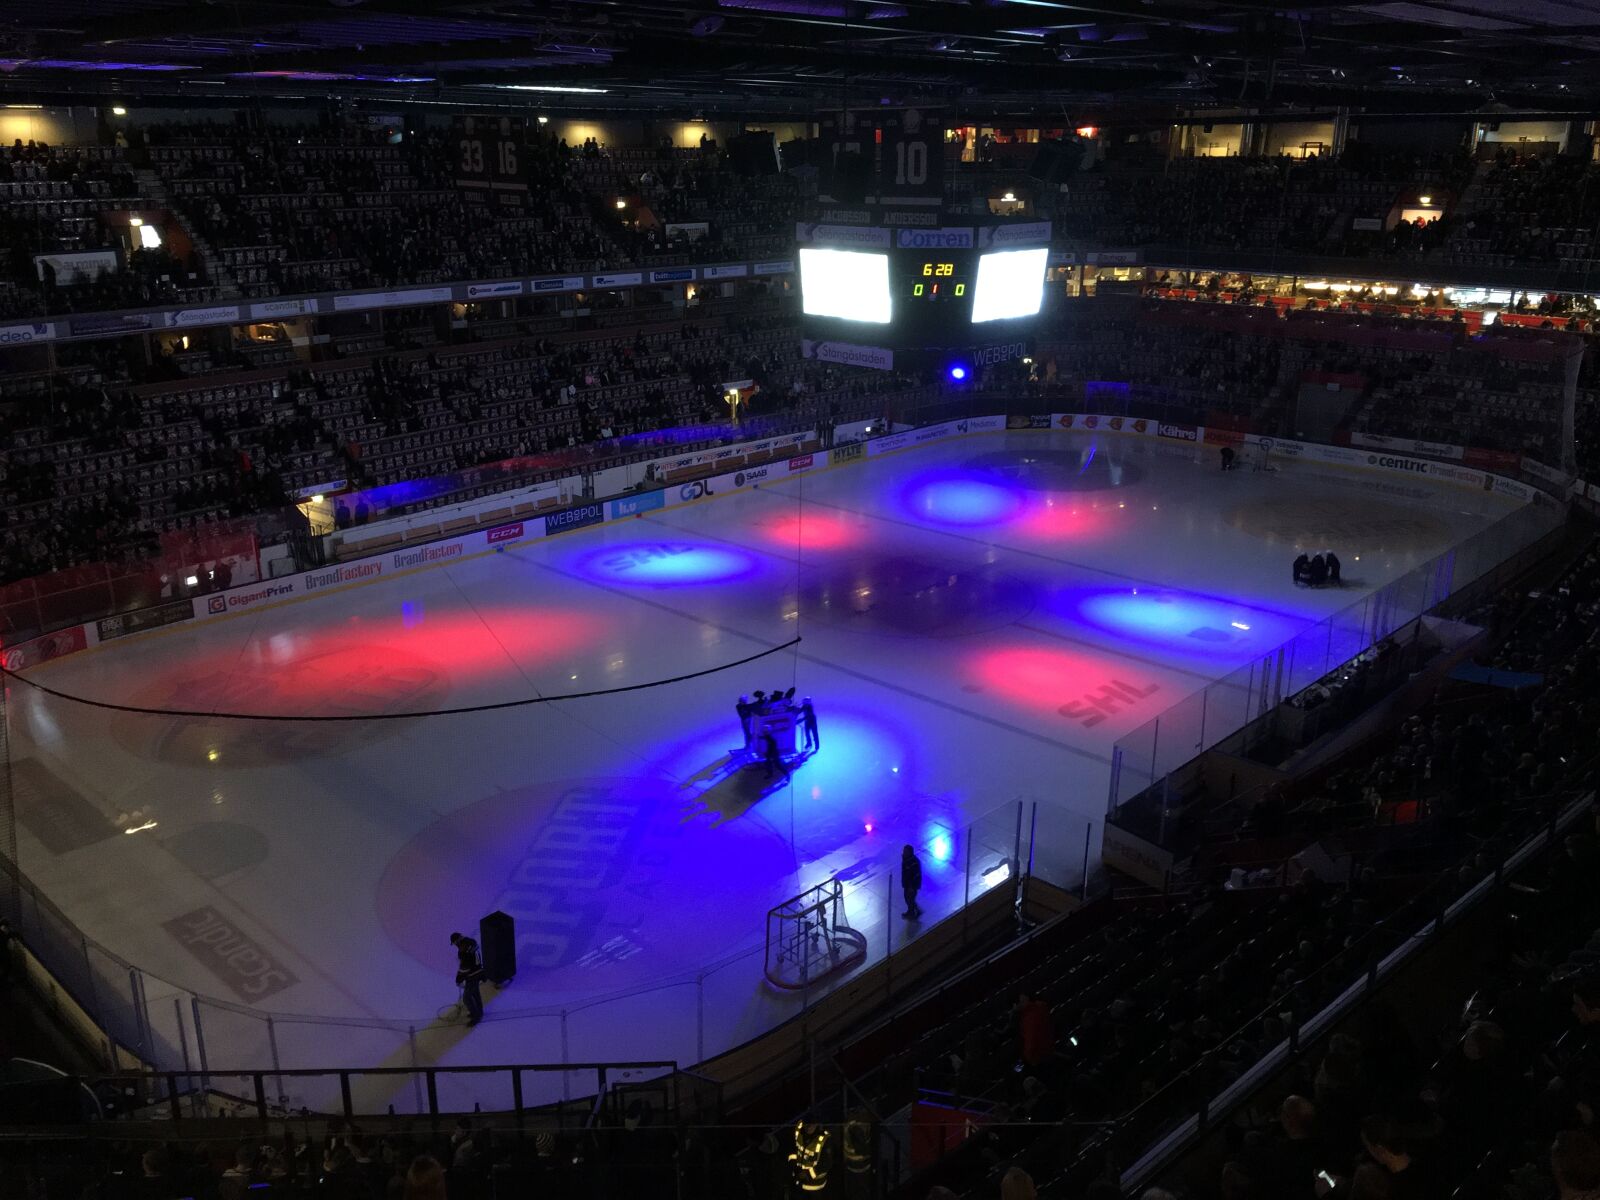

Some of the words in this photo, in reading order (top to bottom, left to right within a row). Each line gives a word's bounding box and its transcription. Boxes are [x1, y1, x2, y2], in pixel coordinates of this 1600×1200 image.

[460, 140, 484, 172] 33
[497, 141, 517, 175] 16
[896, 141, 927, 184] 10
[883, 212, 937, 225] ANDERSSON
[900, 229, 970, 248] Corren
[931, 283, 939, 294] 1
[1159, 424, 1196, 440] Kährs
[661, 459, 693, 471] INTERSPORT
[1379, 456, 1428, 473] centric
[746, 469, 768, 480] SAAB
[490, 527, 521, 539] CCM
[394, 543, 463, 568] BrandFactory
[305, 562, 382, 589] BrandFactory
[228, 584, 293, 606] GigantPrint
